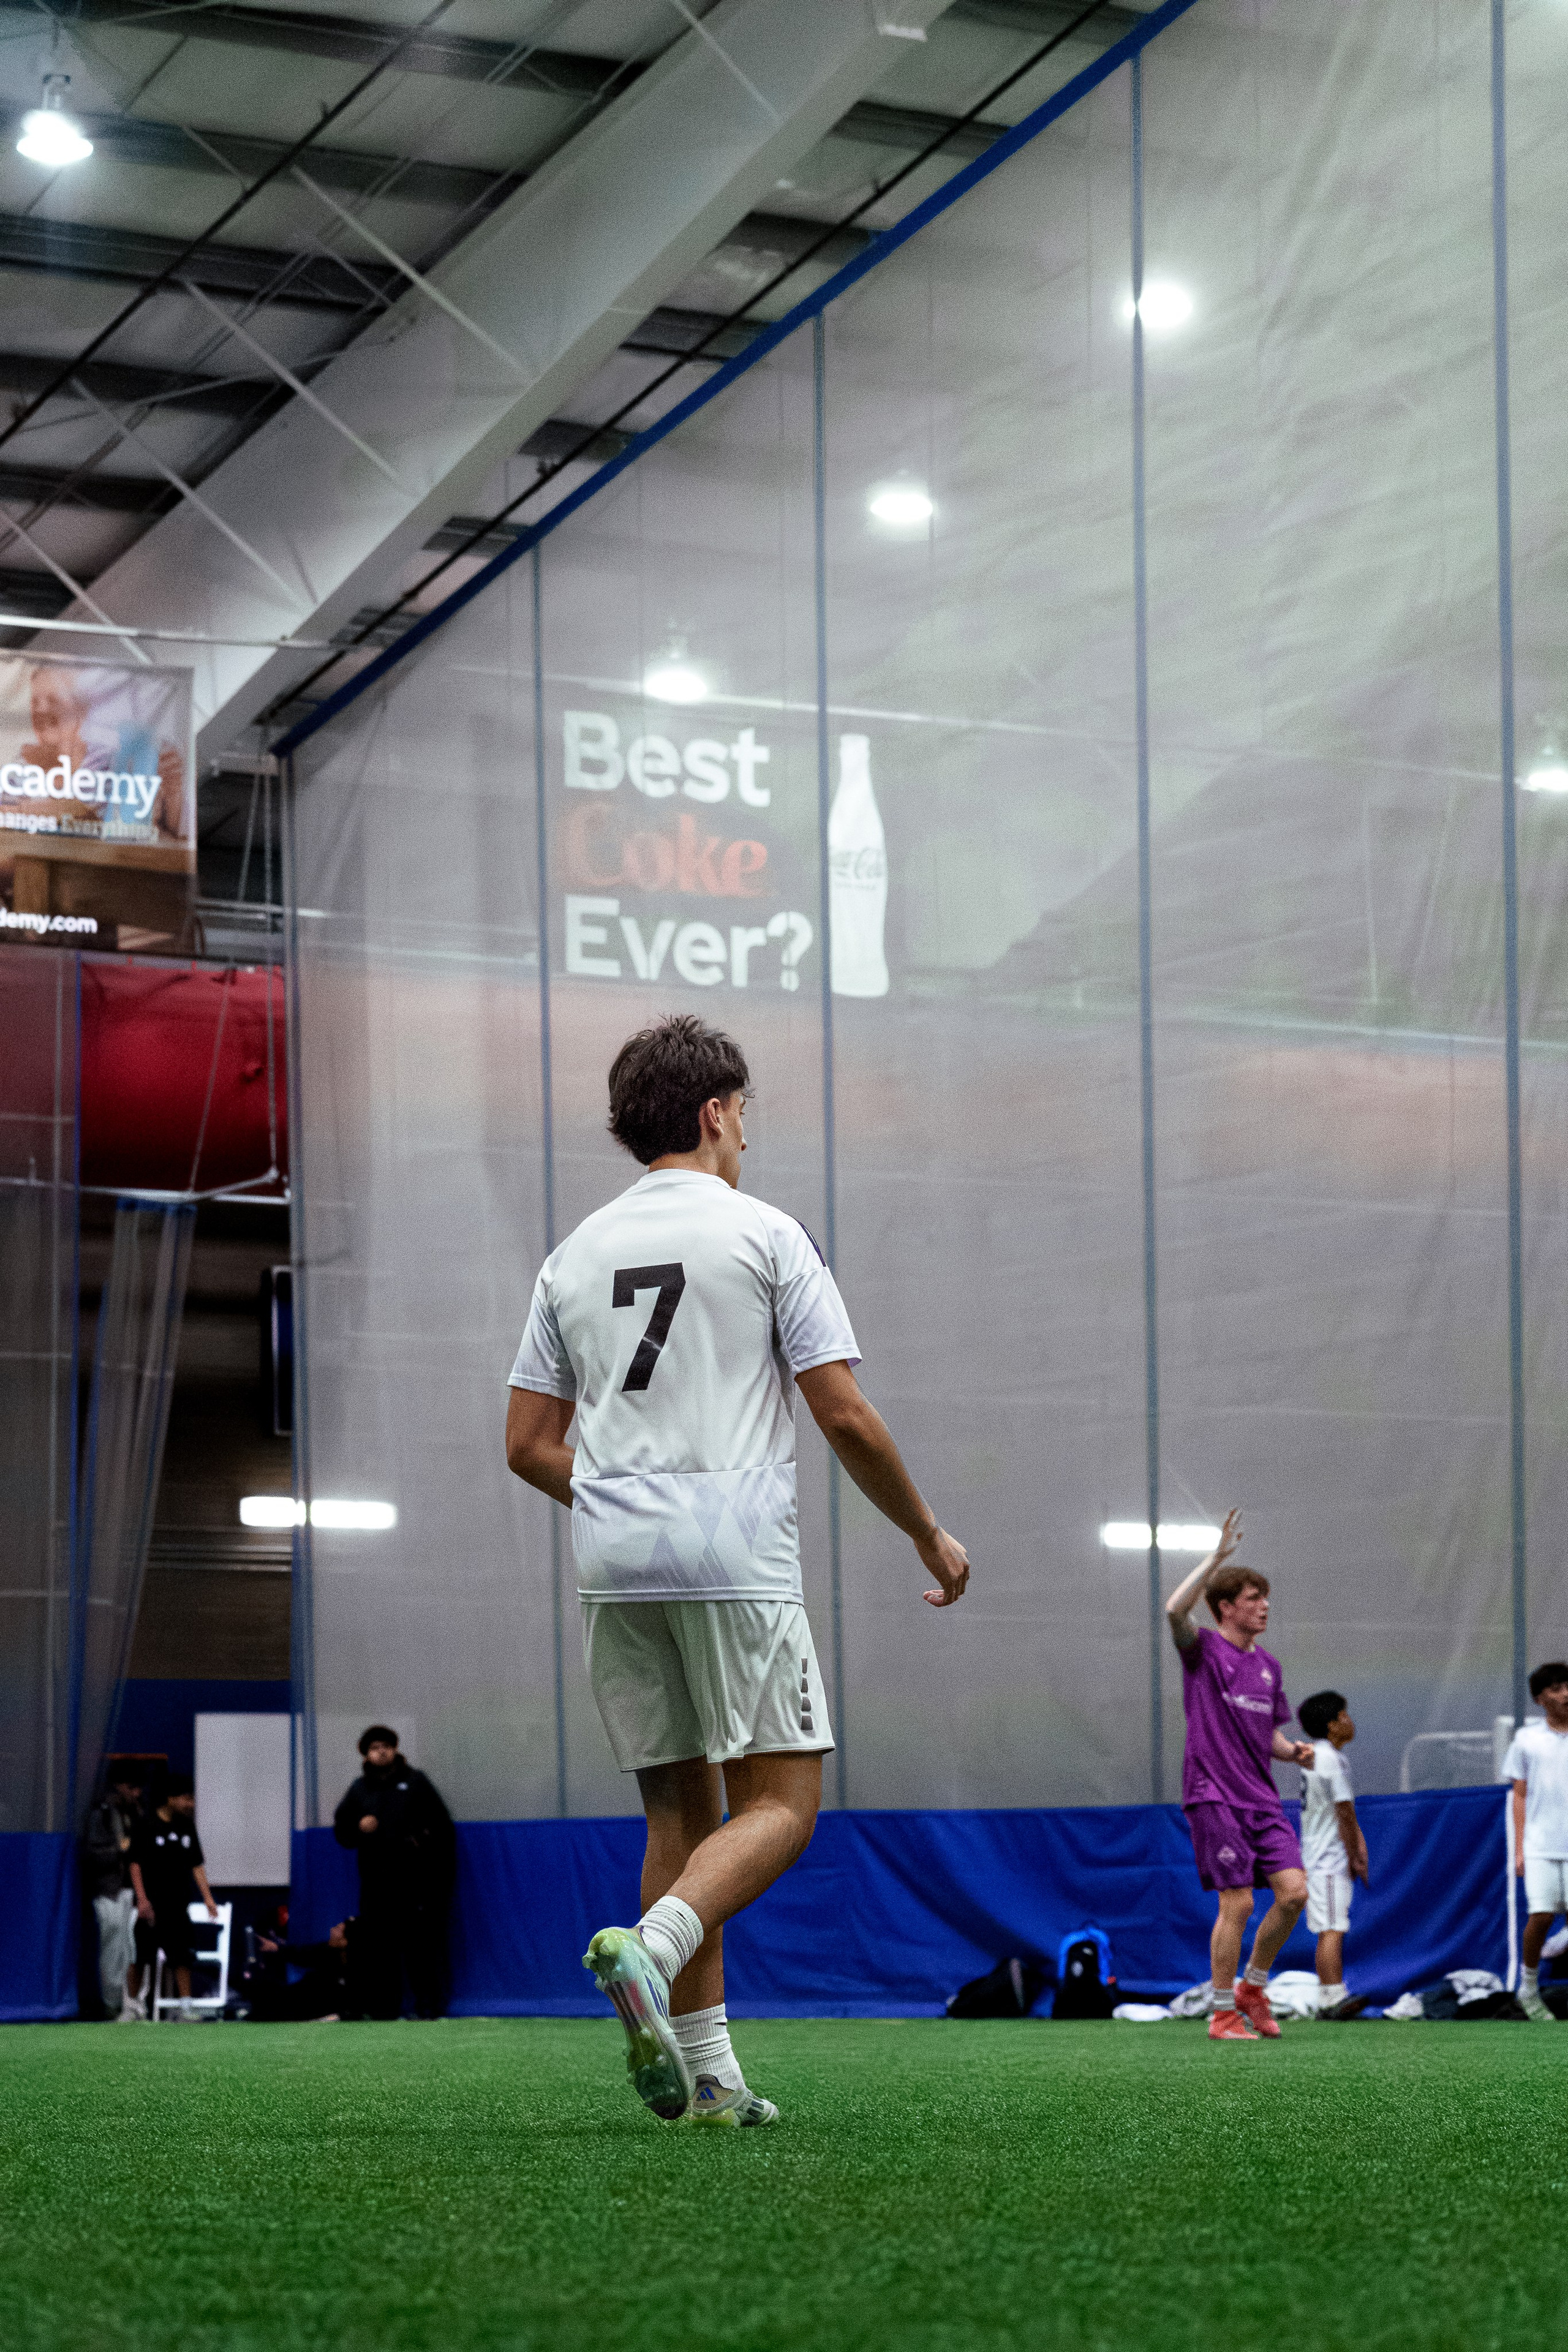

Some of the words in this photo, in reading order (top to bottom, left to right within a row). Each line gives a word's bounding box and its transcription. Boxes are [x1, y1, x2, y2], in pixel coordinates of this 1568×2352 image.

[0, 754, 162, 818] cademy
[564, 710, 771, 808] Best
[563, 801, 773, 898] Coke
[565, 894, 813, 992] Ever?
[612, 1262, 687, 1392] 7
